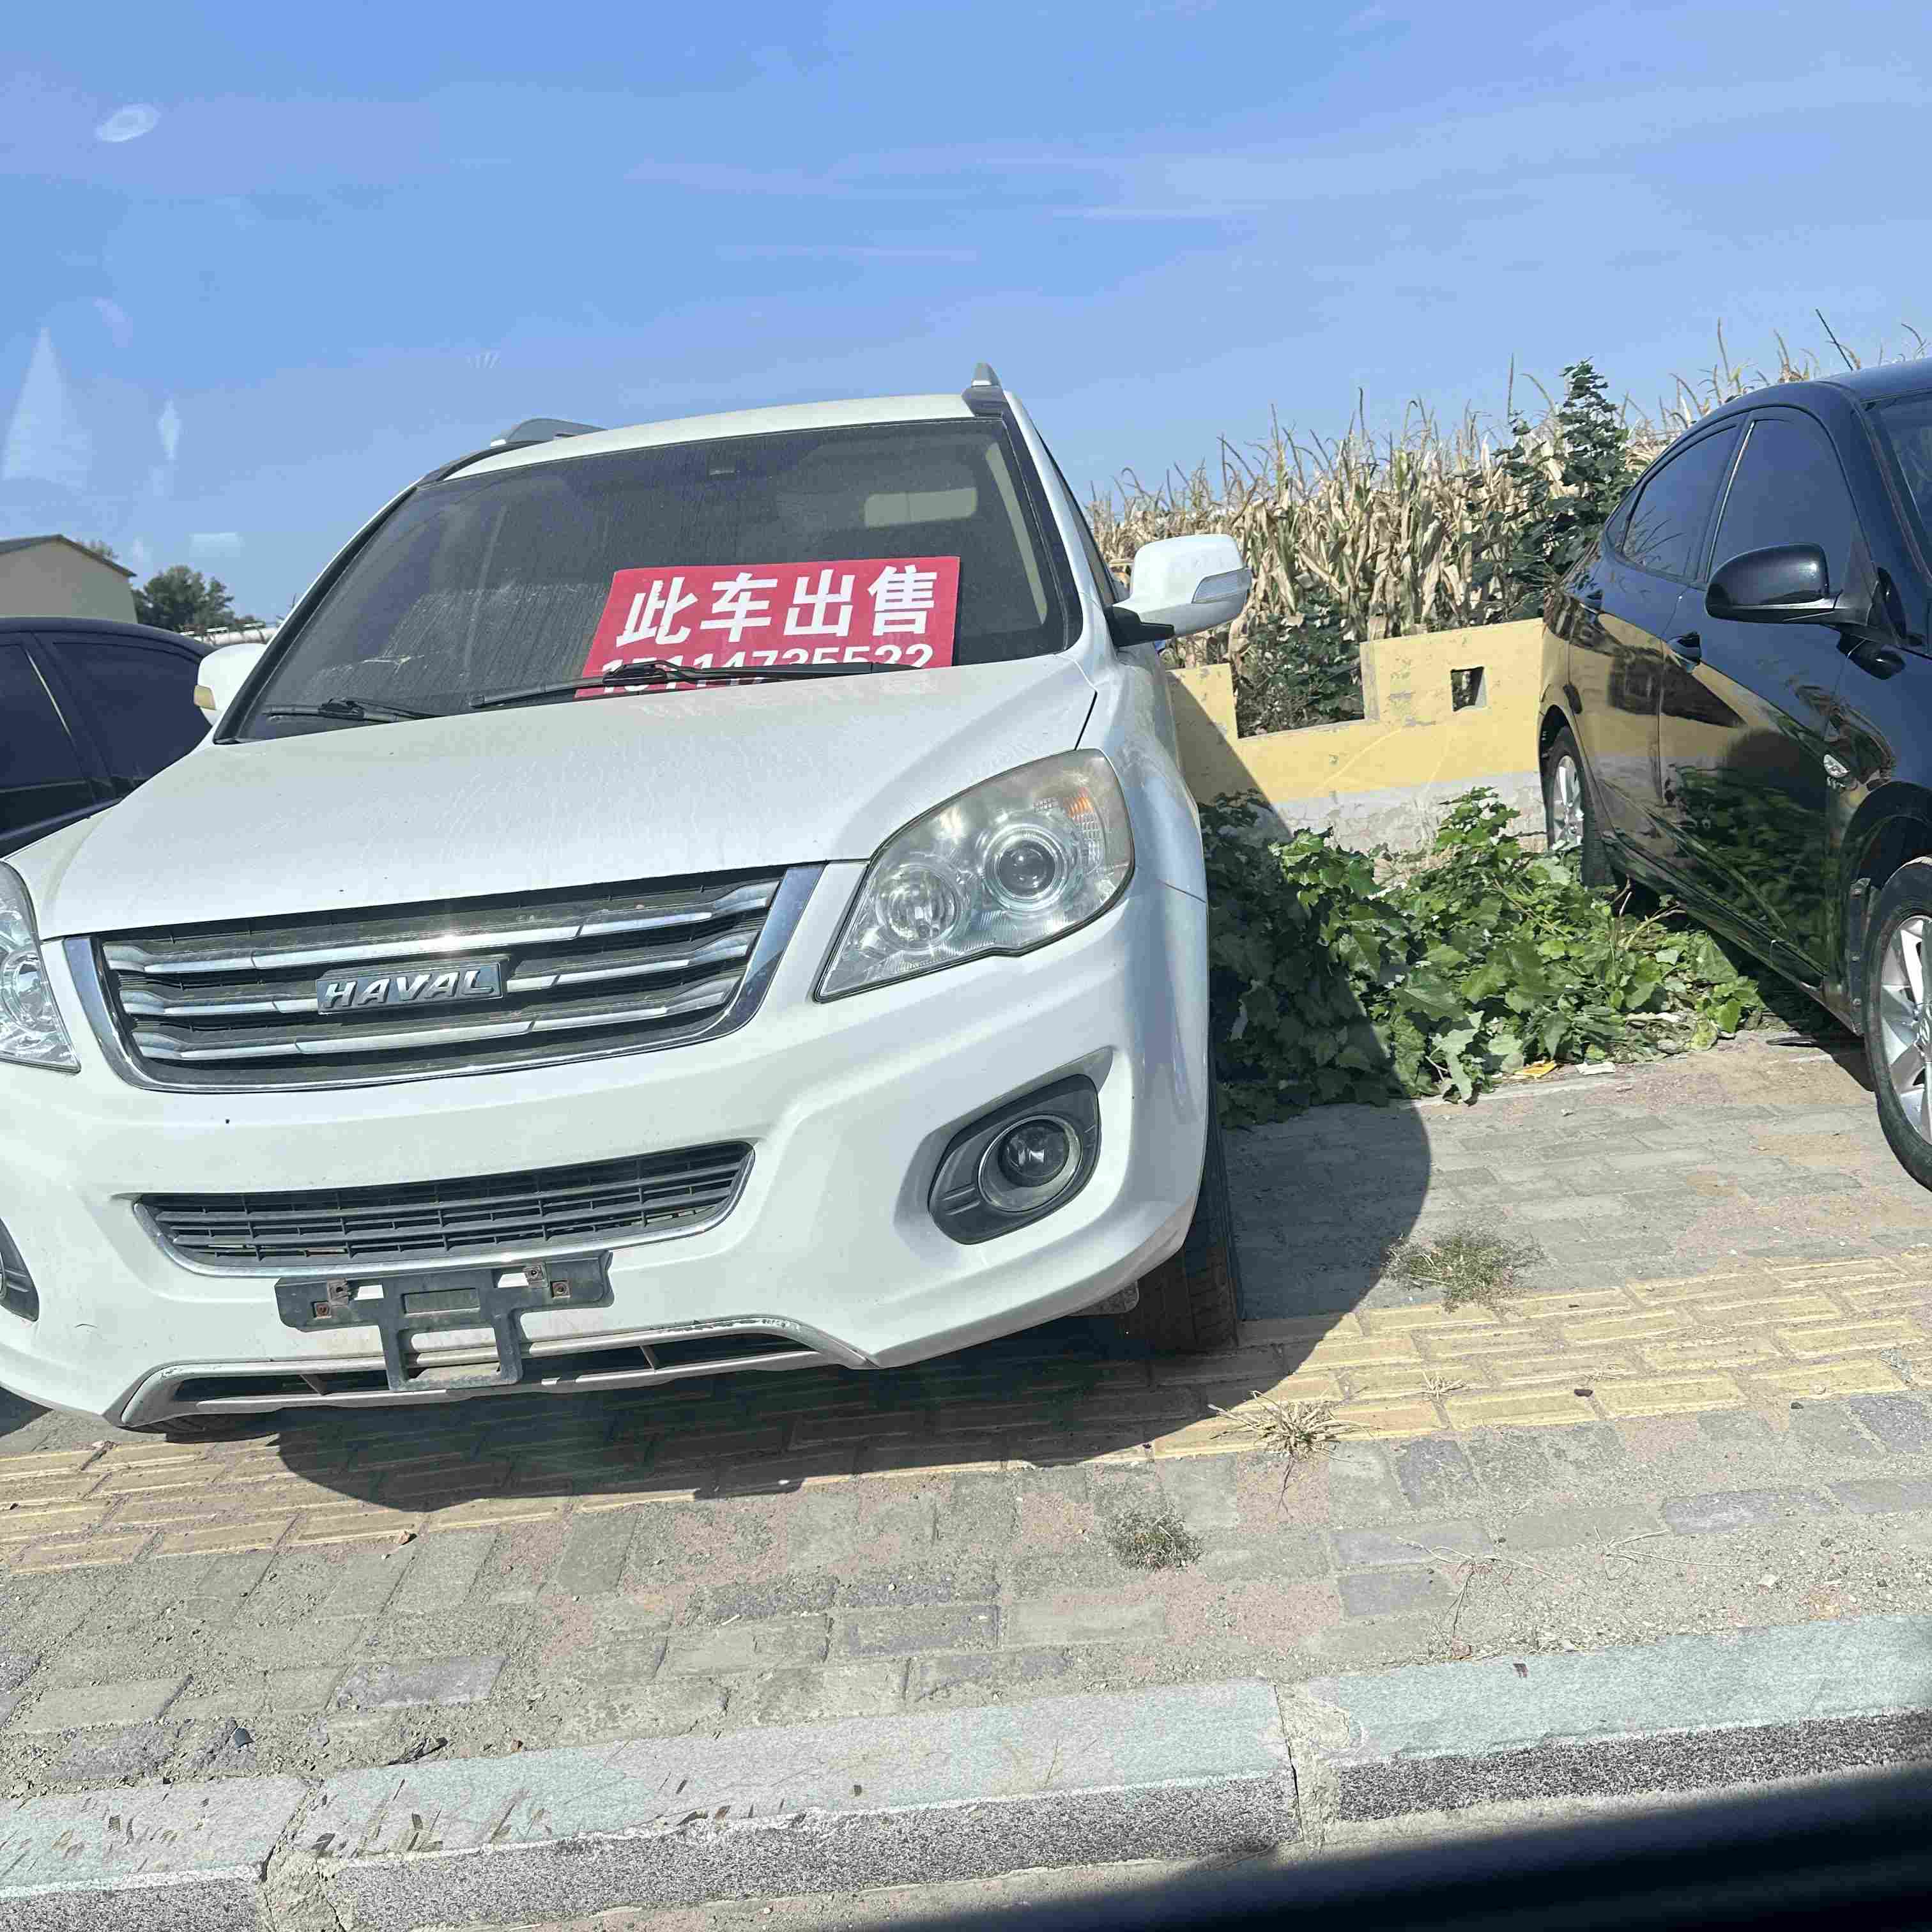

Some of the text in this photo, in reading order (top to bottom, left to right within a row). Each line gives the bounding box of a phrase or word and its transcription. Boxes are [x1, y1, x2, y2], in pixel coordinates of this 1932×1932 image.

[616, 565, 937, 647] 此车出售
[321, 970, 494, 1008] HAVAL
